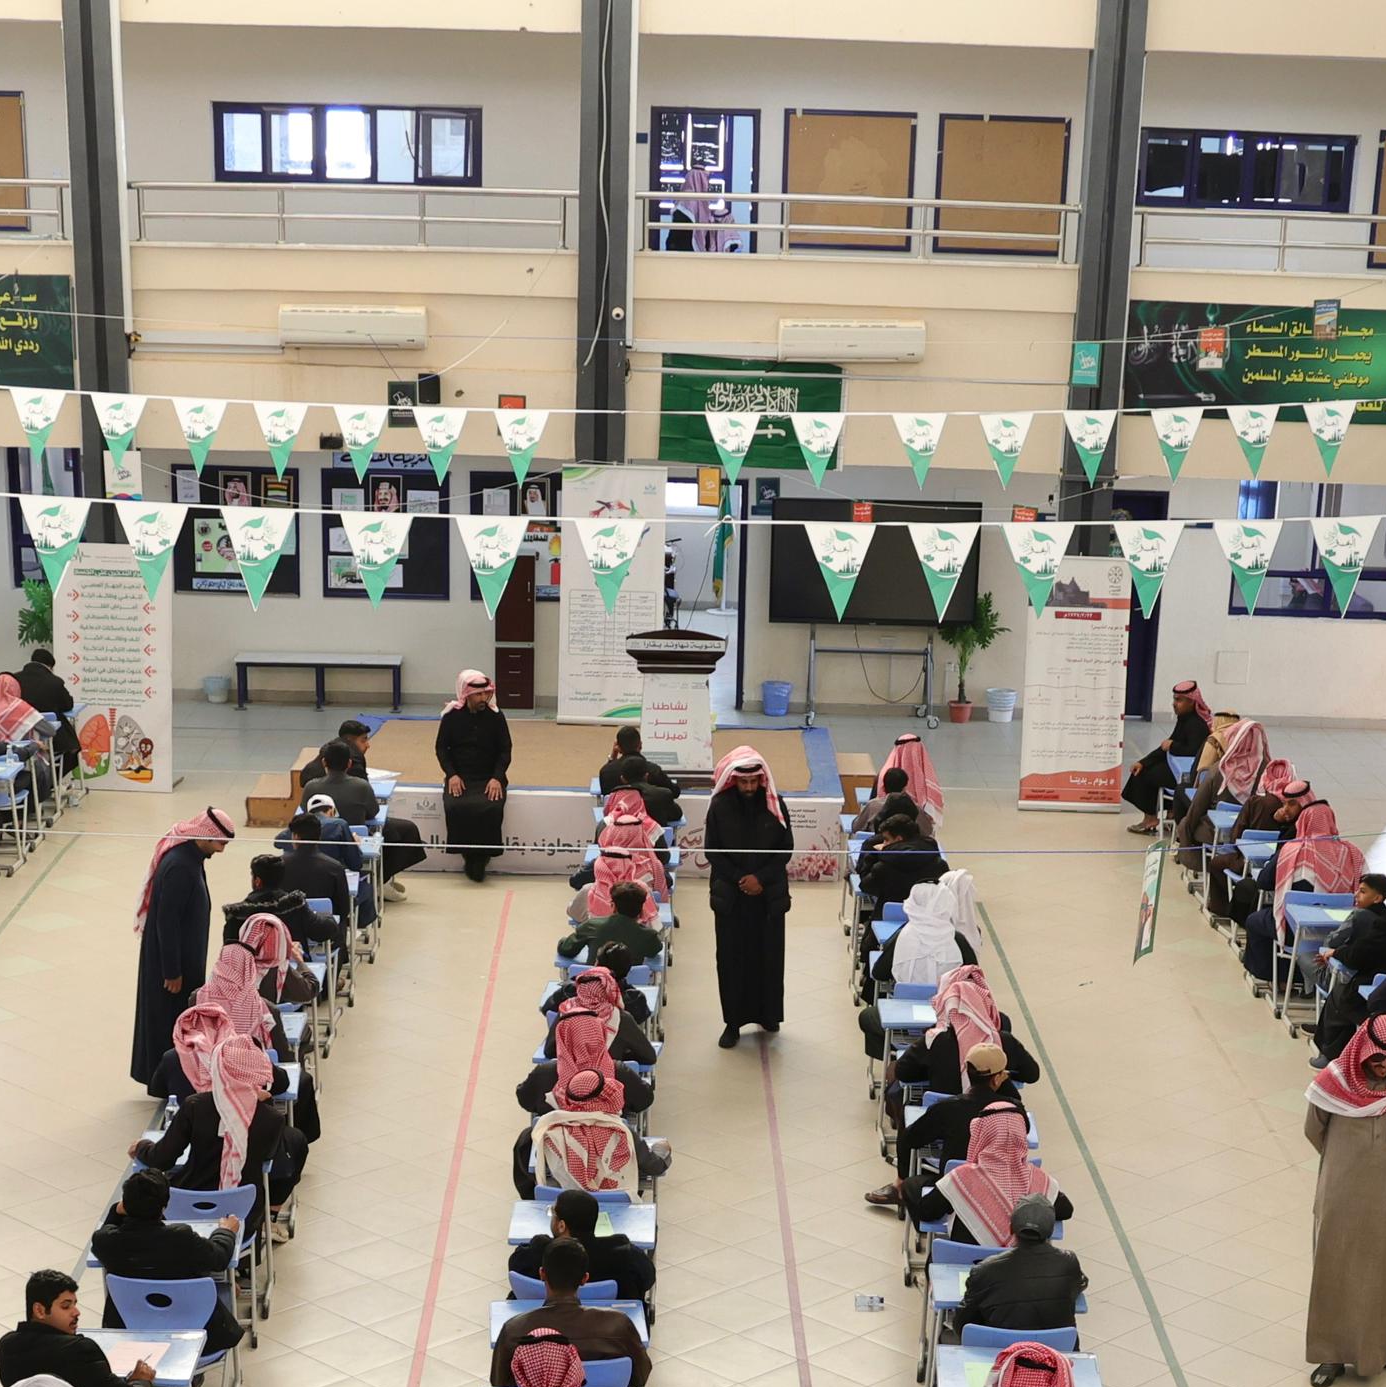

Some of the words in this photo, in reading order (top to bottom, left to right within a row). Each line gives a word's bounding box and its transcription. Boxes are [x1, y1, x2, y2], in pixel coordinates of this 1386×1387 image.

[1246, 320, 1288, 334] السماء
[1288, 346, 1328, 361] النور
[1330, 348, 1372, 365] يحمل
[1242, 367, 1281, 384] المسلمين
[1283, 368, 1305, 384] فخر
[1306, 368, 1331, 383] عشت
[1333, 372, 1370, 389] موطني
[663, 641, 690, 650] نهاوند
